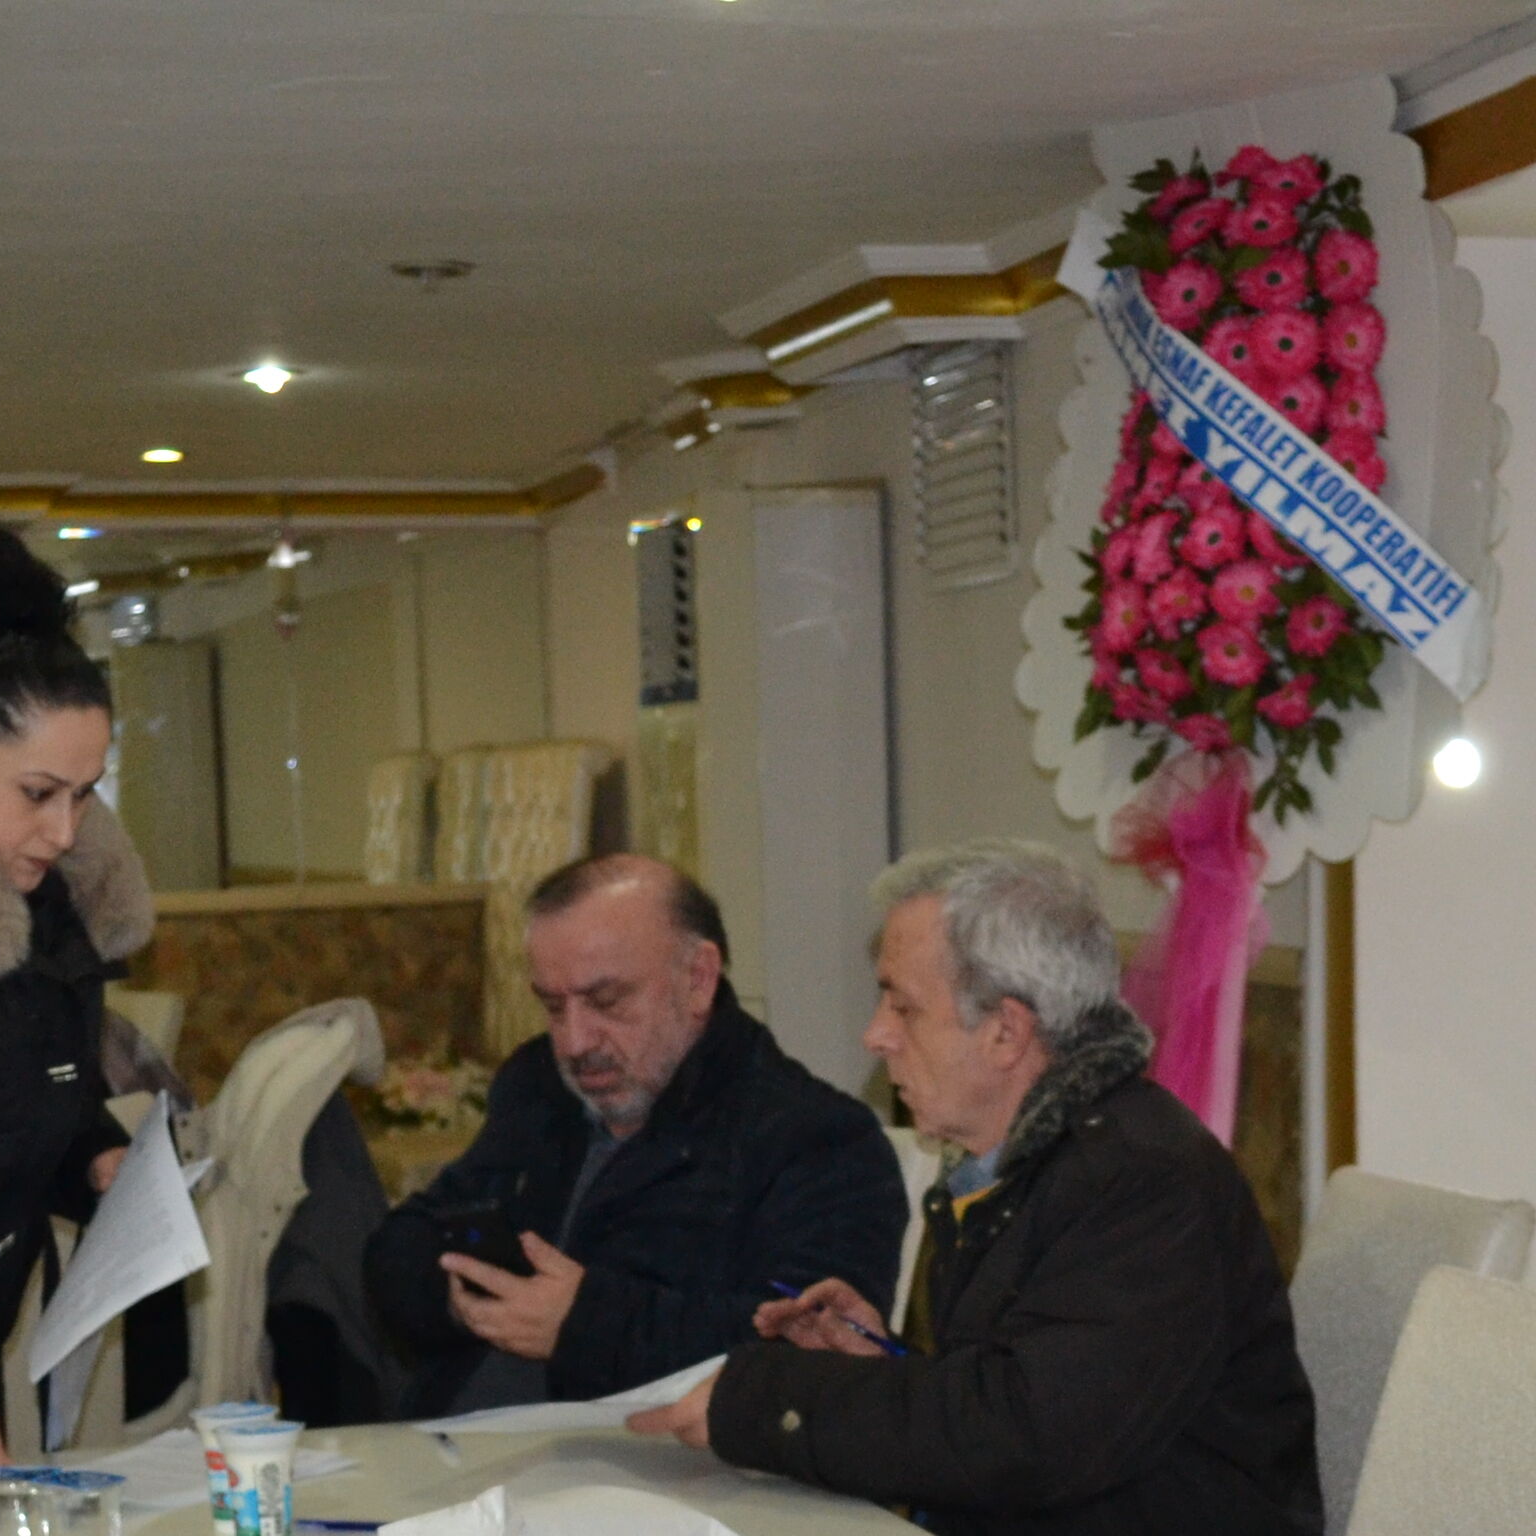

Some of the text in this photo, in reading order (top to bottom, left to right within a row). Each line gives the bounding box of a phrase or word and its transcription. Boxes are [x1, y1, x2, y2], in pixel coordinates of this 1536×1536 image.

[1204, 377, 1309, 472] KEFALET
[1297, 460, 1470, 618] KOOPERATİFİ
[1204, 427, 1438, 643] YILMAZ
